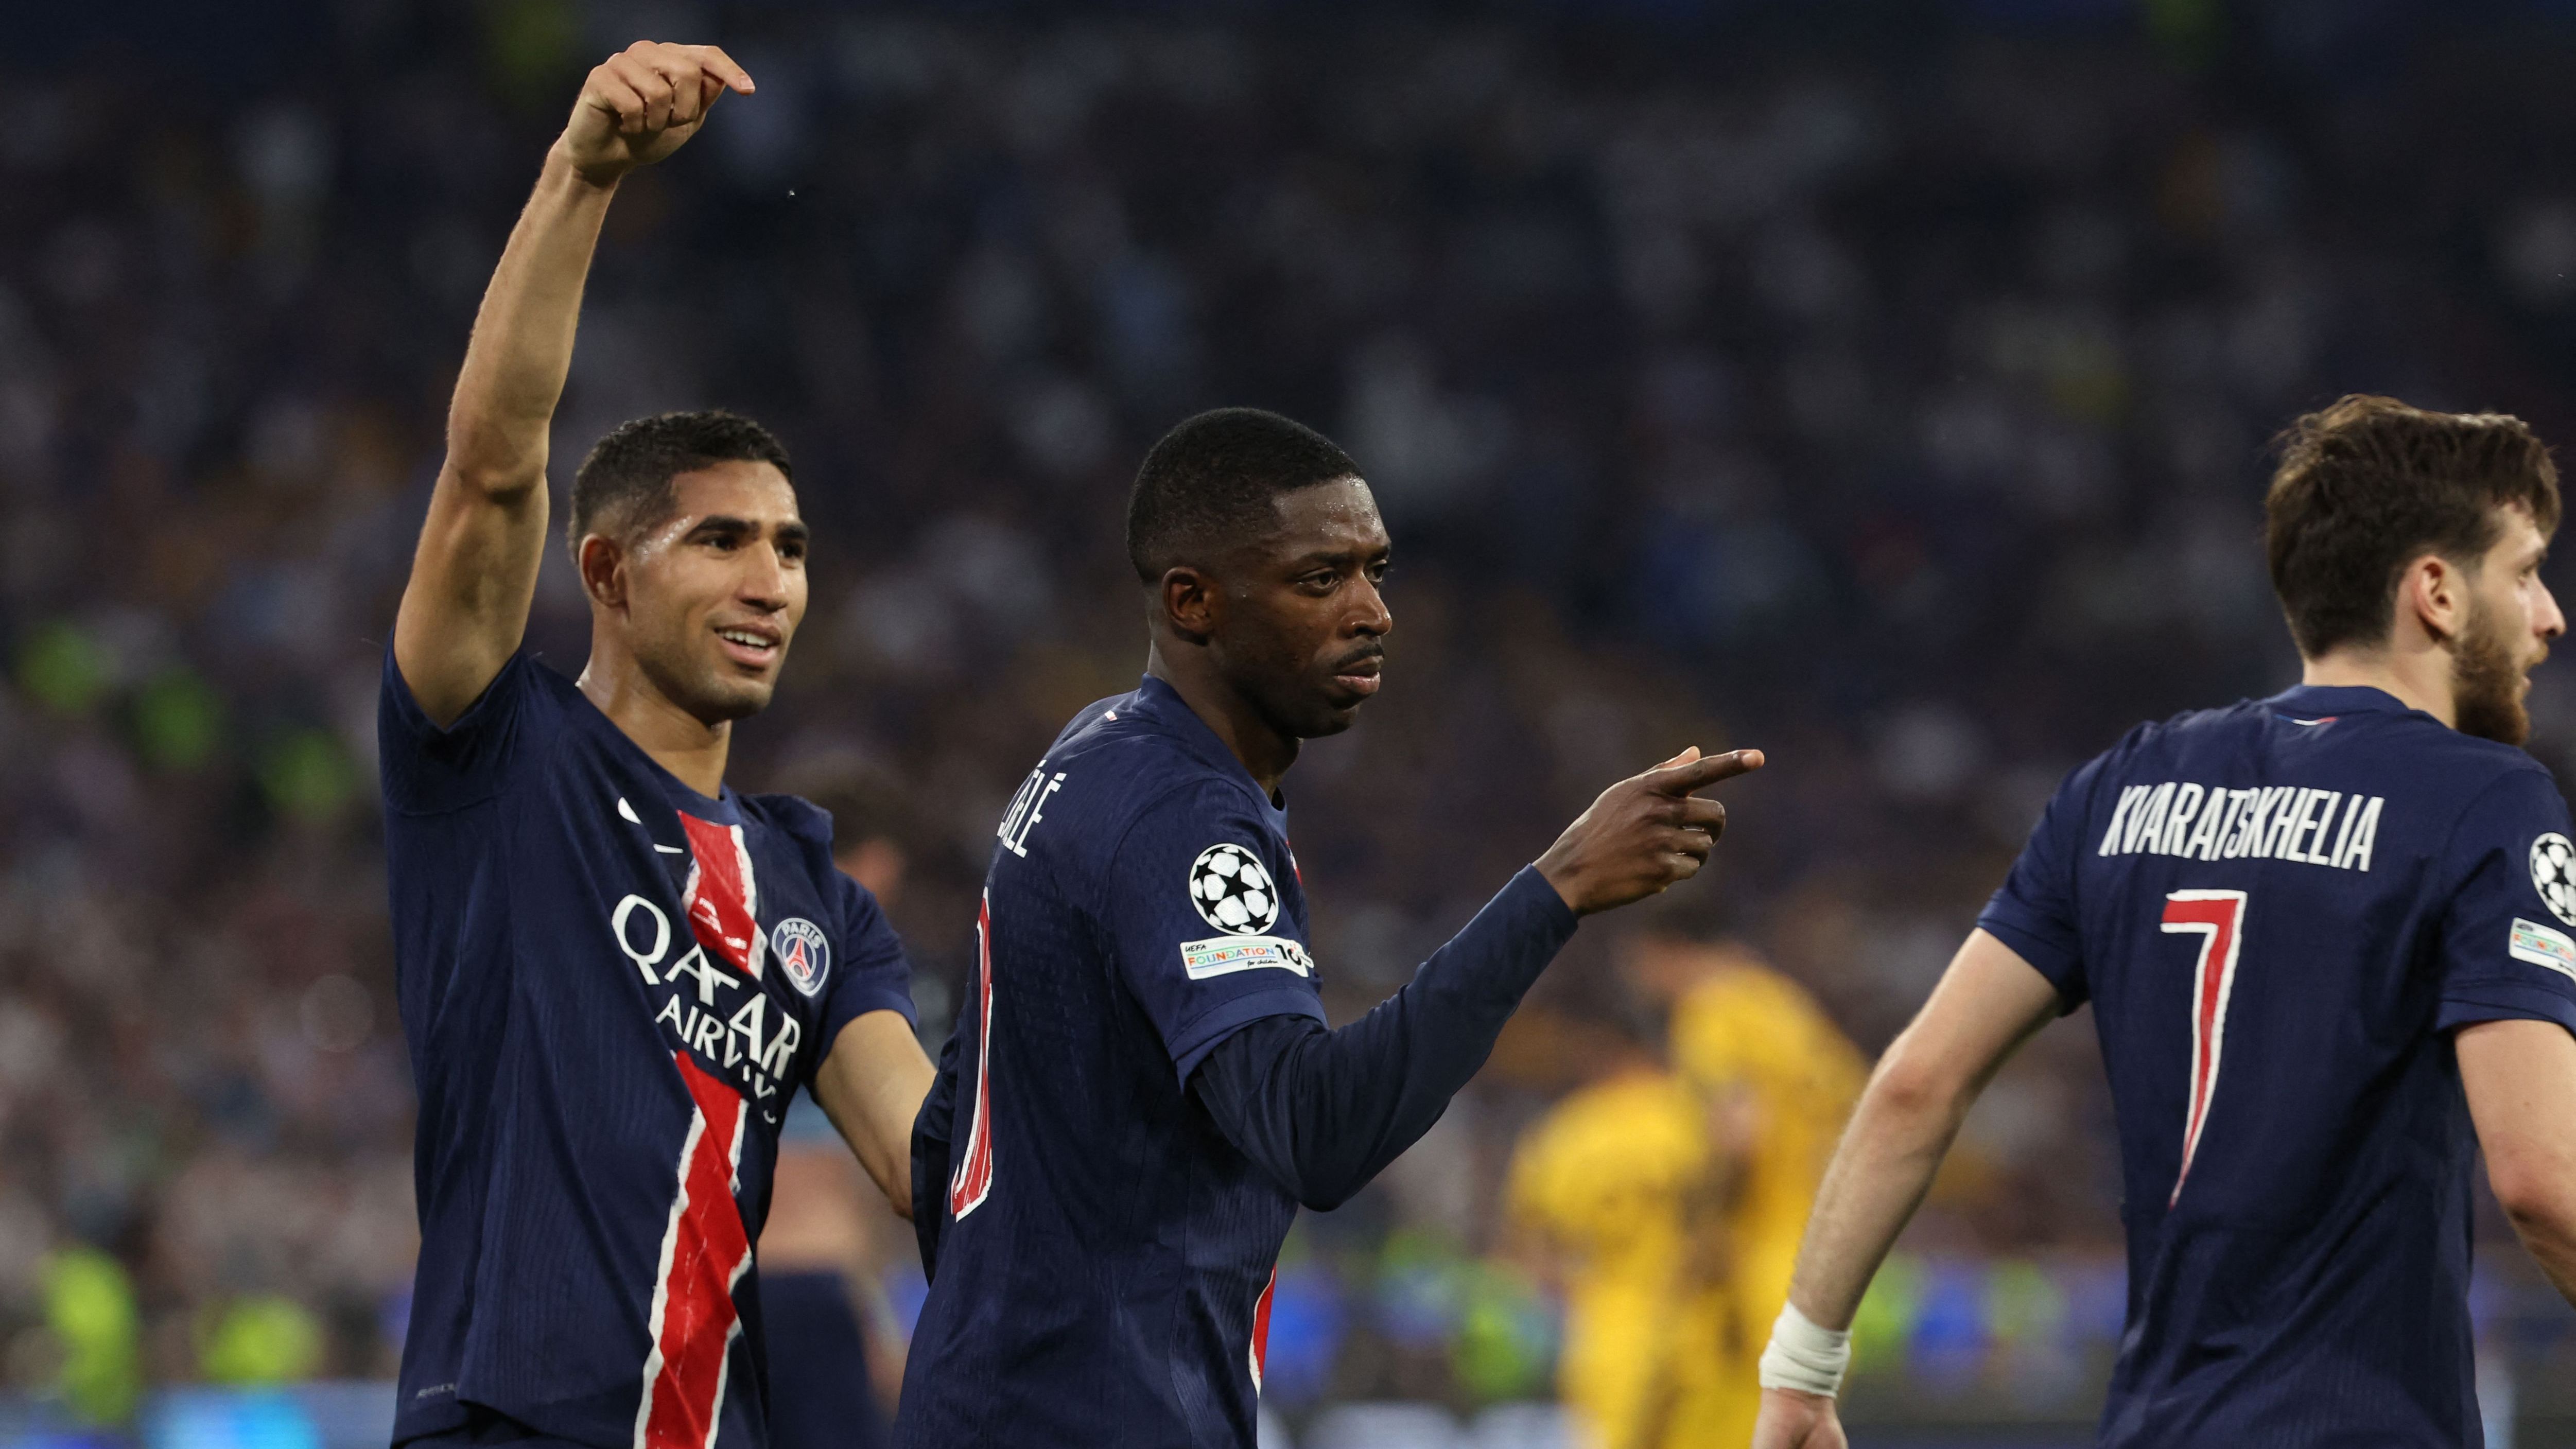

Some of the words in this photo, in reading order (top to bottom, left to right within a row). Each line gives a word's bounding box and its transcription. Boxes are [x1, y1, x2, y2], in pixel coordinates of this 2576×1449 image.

[2098, 781, 2385, 872] KVARATSKHELIA
[781, 922, 823, 949] PARIS
[1185, 944, 1206, 952] UEFA
[1188, 947, 1275, 966] FOUNDATION
[611, 894, 801, 1080] QATAR
[2160, 889, 2248, 1211] 7
